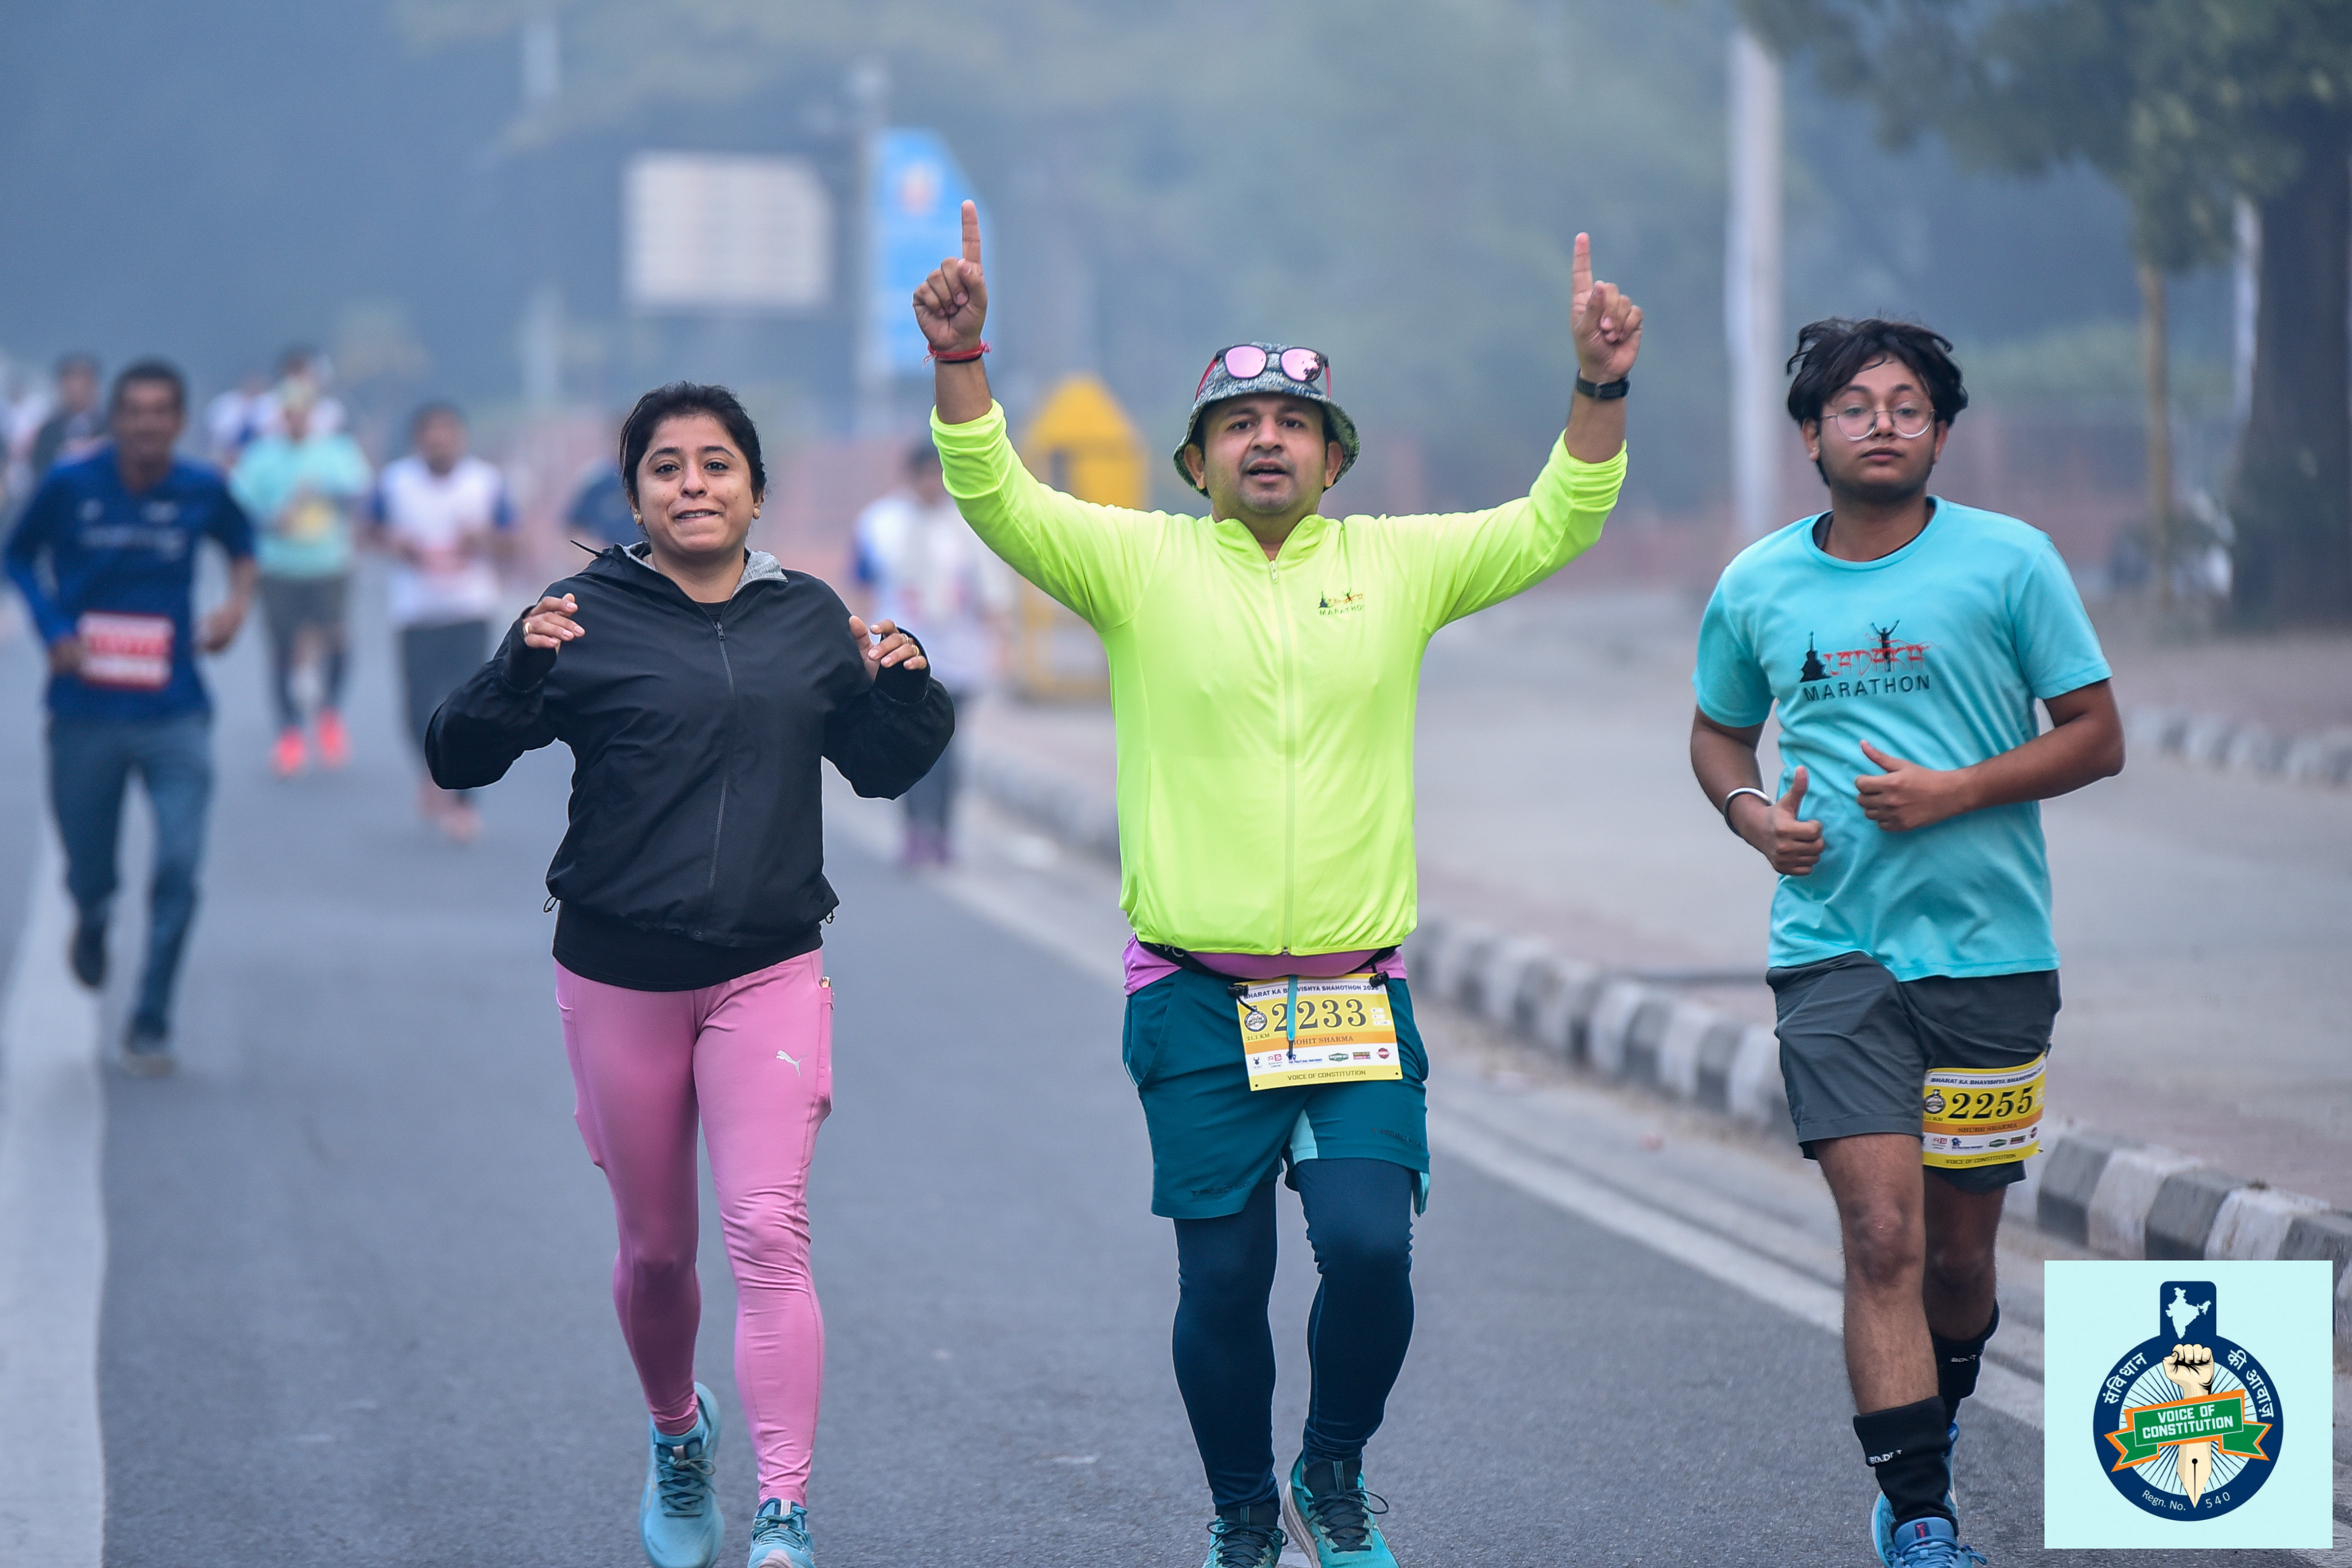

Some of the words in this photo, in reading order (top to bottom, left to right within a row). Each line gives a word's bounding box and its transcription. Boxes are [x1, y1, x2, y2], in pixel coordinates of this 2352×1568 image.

[1803, 675, 1930, 701] MARATHON
[1244, 990, 1270, 999] BHARAT
[1283, 985, 1321, 994] BVISHYA
[1271, 999, 1367, 1032] 2233
[1318, 1070, 1366, 1078] CONSTITUTION
[1948, 1085, 2034, 1119] 2255
[1987, 1123, 2017, 1132] SHARMA
[1975, 1154, 2017, 1163] CONSTITUTION
